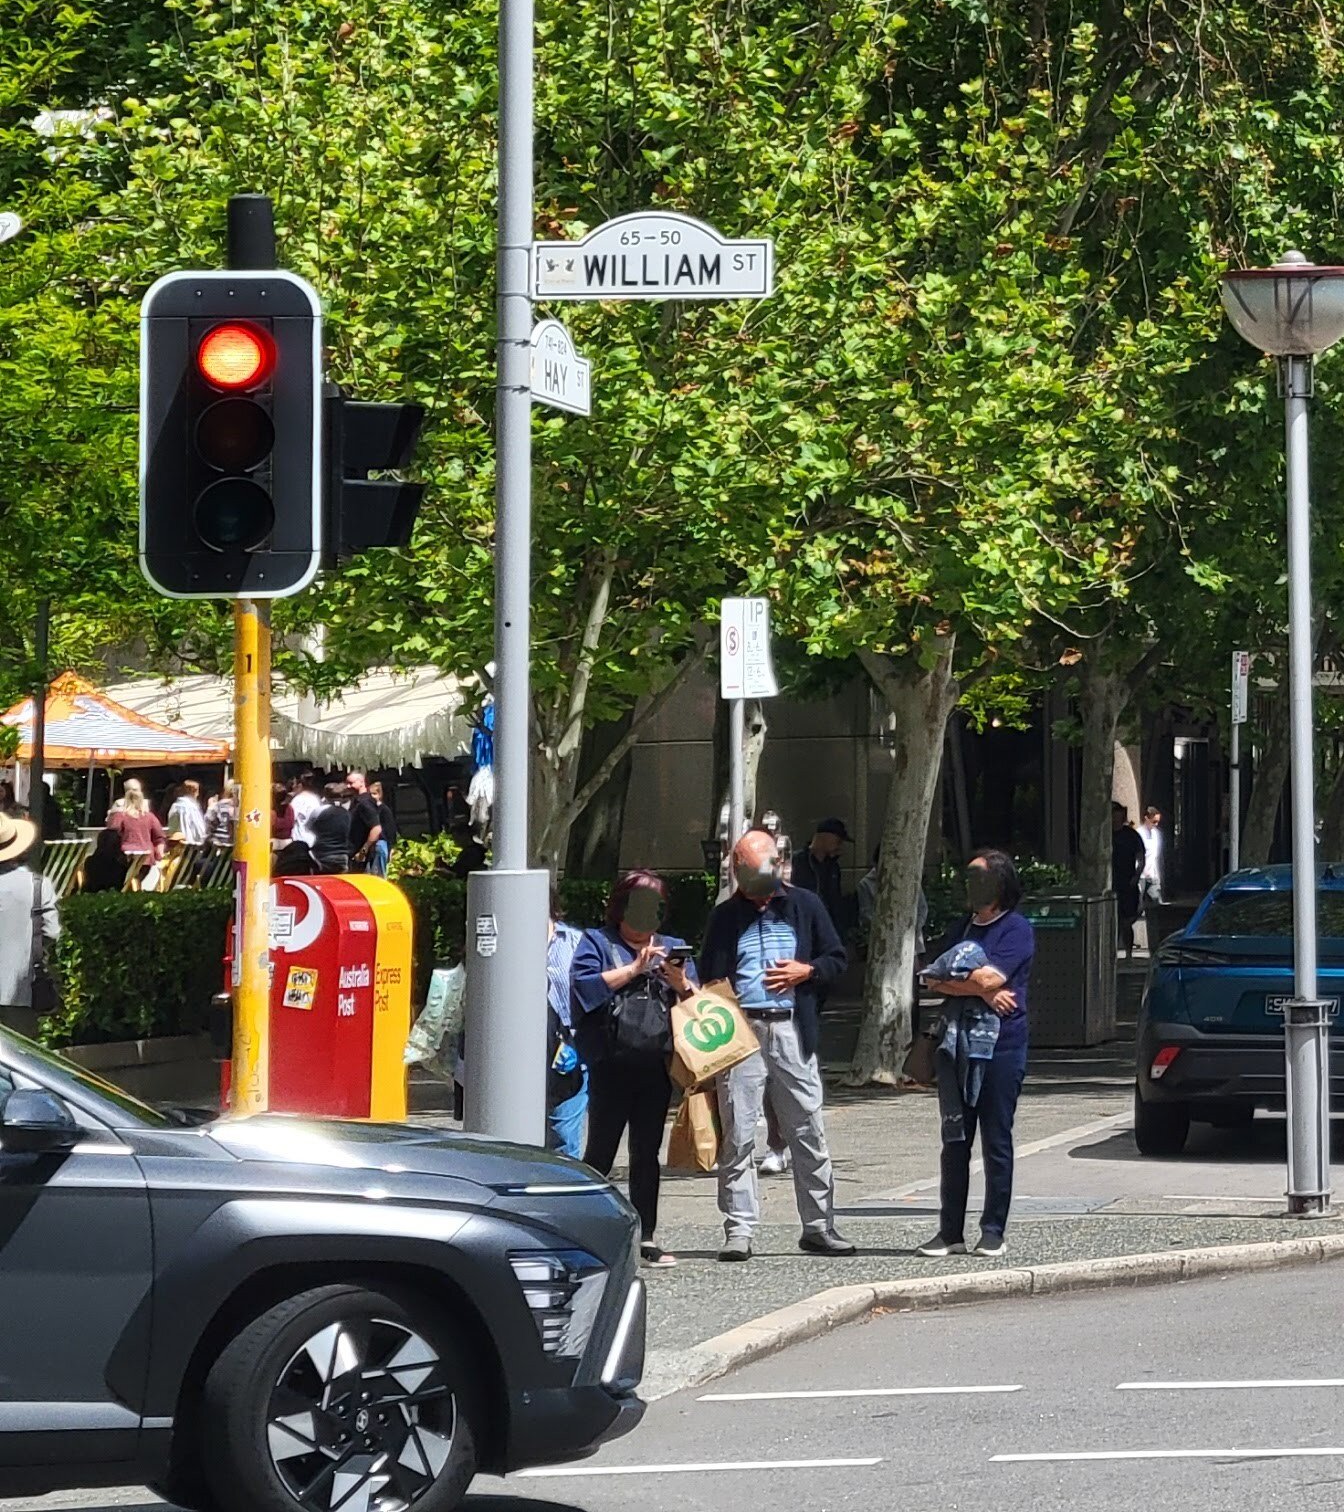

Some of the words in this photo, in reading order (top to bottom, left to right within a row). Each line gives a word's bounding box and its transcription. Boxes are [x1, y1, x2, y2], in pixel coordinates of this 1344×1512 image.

[620, 230, 682, 246] 65-50
[583, 253, 721, 287] WILLIAM
[732, 253, 757, 271] ST
[544, 358, 568, 396] HAY
[576, 370, 585, 389] ST
[750, 601, 763, 623] 1P
[246, 653, 252, 673] 1
[339, 963, 370, 989] Australia
[375, 962, 401, 986] Express
[337, 993, 355, 1016] Post
[375, 990, 390, 1012] Post
